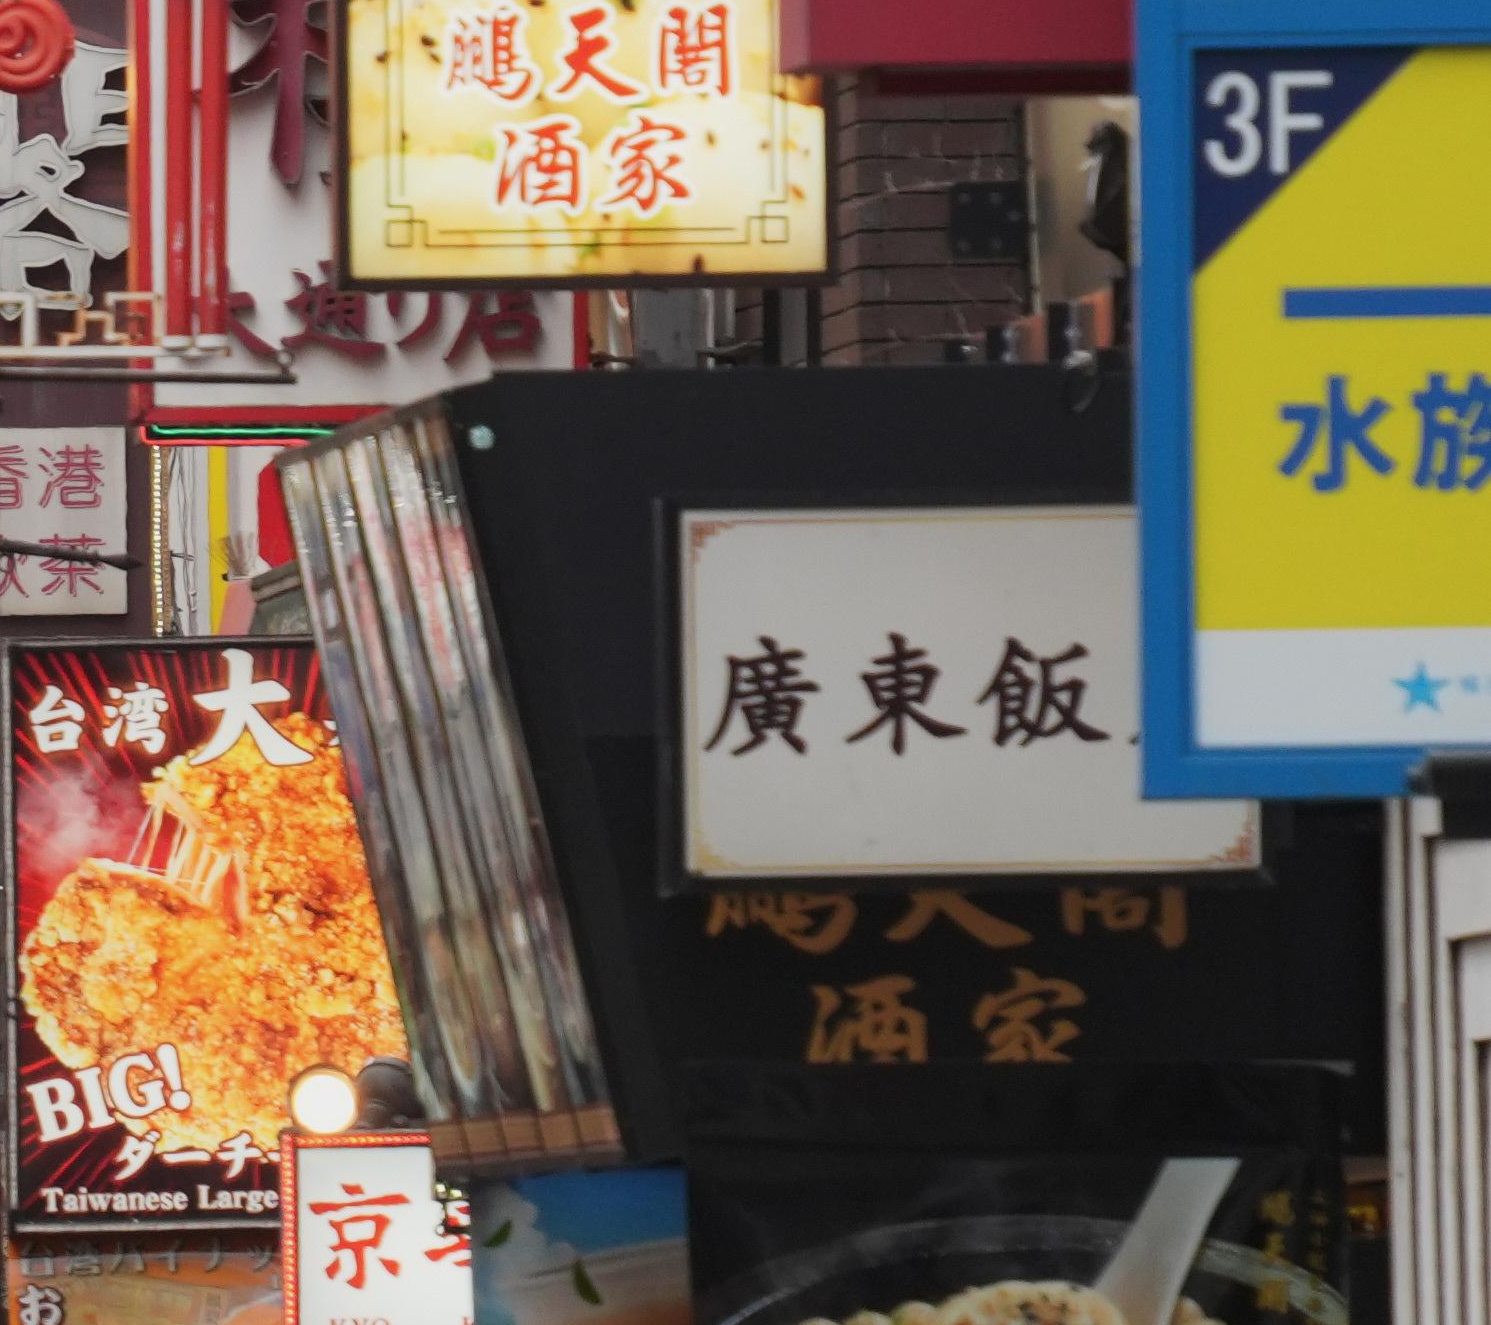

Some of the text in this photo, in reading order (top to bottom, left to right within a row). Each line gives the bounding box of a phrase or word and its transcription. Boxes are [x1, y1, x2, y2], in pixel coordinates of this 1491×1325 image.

[495, 116, 693, 211] 酒家
[1202, 71, 1333, 177] 3F
[704, 632, 1140, 757] 廣東飯
[26, 1043, 191, 1143] BIG!
[40, 1185, 279, 1213] Taiwanese Large
